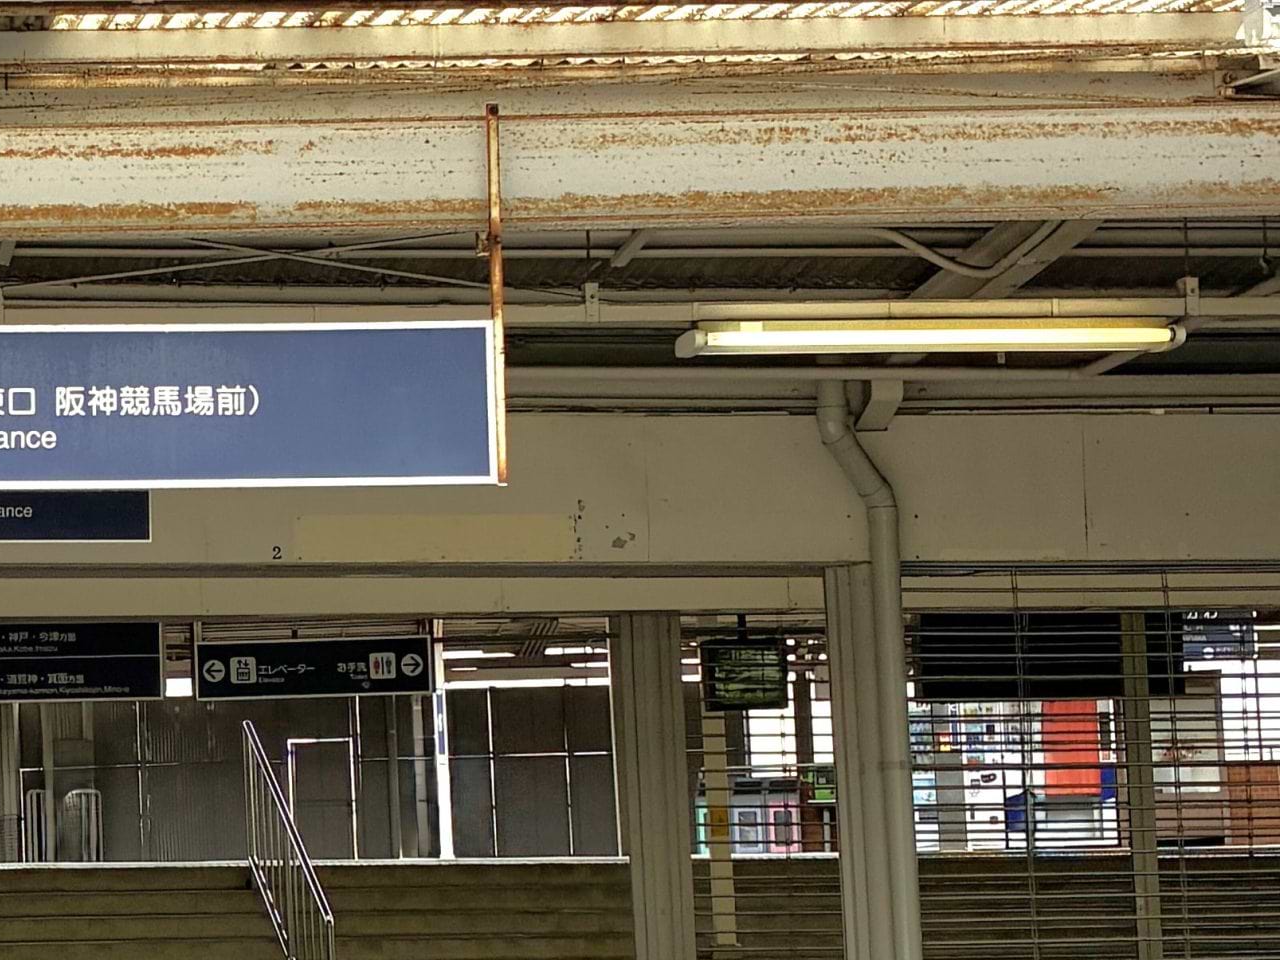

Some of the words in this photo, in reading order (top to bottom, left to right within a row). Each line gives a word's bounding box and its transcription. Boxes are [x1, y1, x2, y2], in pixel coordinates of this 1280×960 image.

[272, 546, 283, 560] 2
[257, 663, 316, 675] エレベーター
